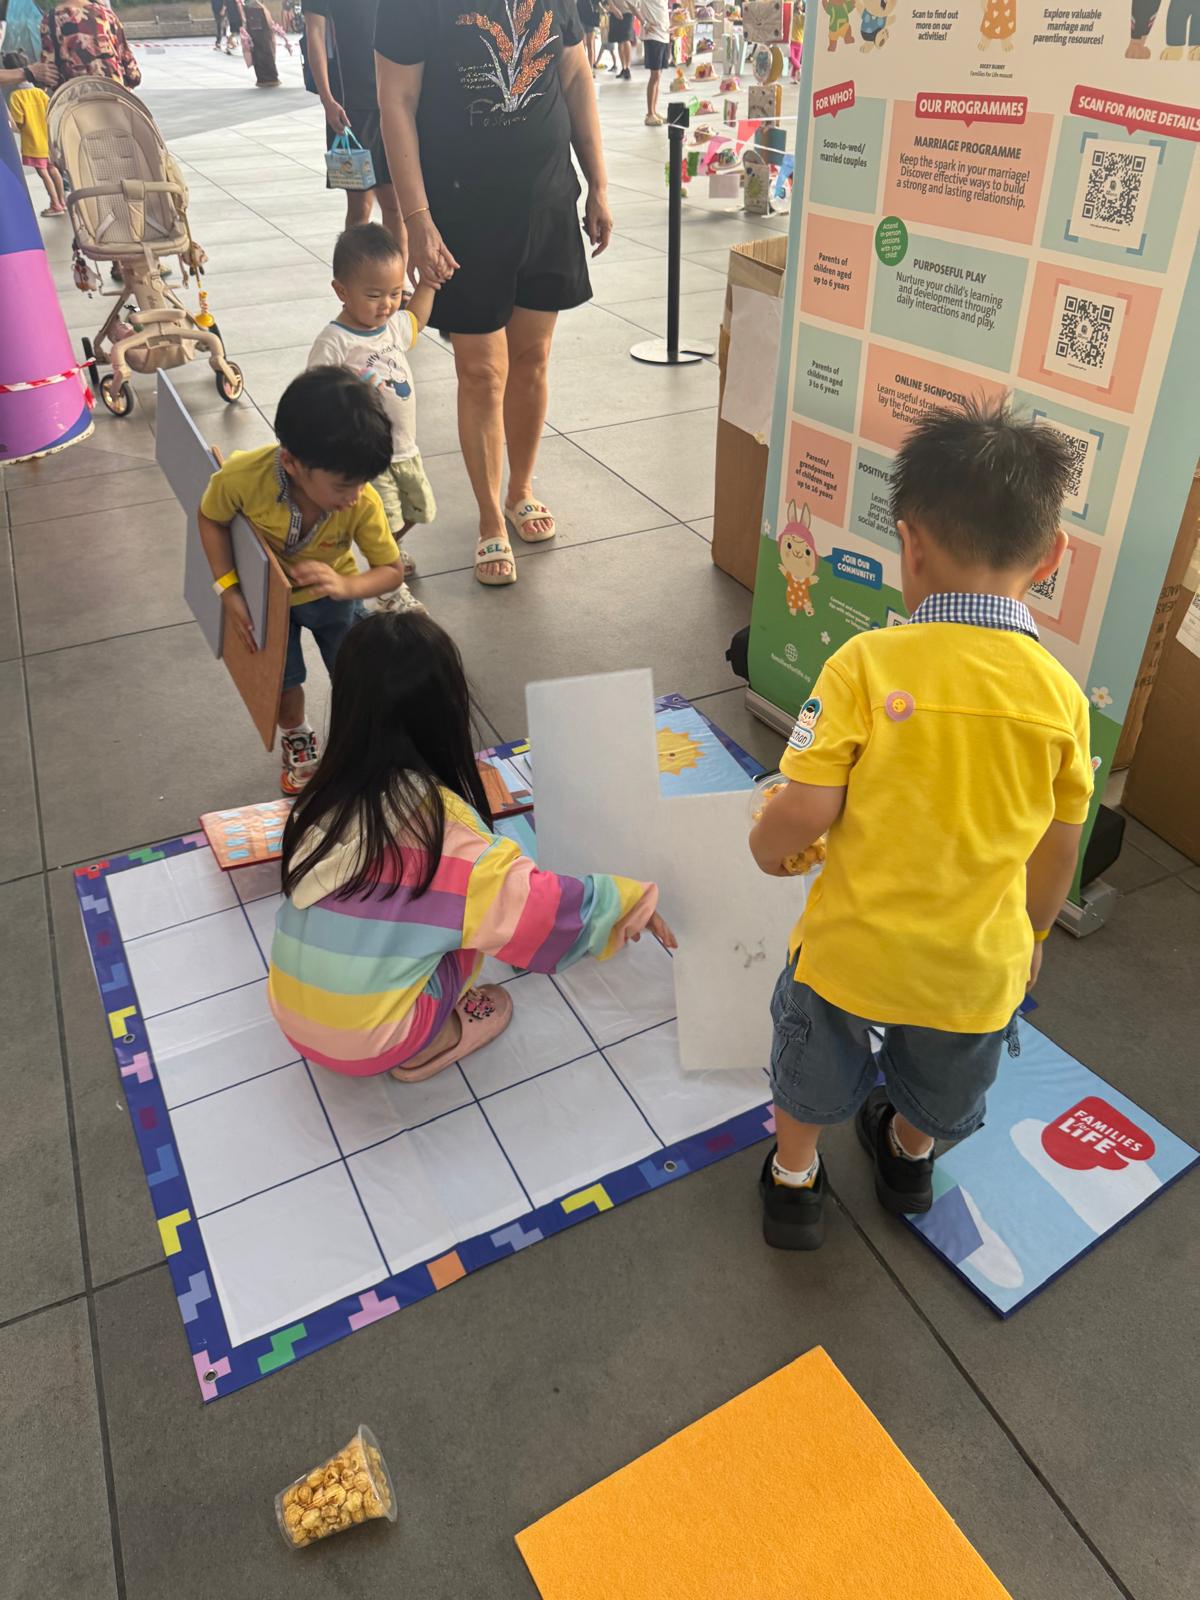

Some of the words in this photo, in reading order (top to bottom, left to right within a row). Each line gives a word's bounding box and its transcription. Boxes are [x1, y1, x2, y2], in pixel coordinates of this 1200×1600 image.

[912, 9, 926, 19] Scan
[927, 10, 933, 19] to
[934, 10, 947, 19] find
[947, 11, 958, 20] out
[1043, 8, 1070, 20] Explore
[1071, 9, 1102, 20] valuable
[915, 22, 931, 30] more
[932, 22, 940, 30] on
[941, 22, 952, 30] our
[1047, 21, 1078, 33] marriage
[1079, 22, 1094, 32] and
[918, 31, 947, 41] activities!
[1033, 33, 1067, 46] parenting
[1068, 34, 1104, 45] resources!
[815, 96, 829, 111] FOR
[829, 88, 854, 106] WHO?
[919, 98, 942, 113] OUR
[943, 99, 1025, 117] PROGRAMMES
[1078, 95, 1105, 113] SCAN
[1105, 100, 1125, 117] FOR
[1125, 105, 1158, 124] MORE
[1158, 111, 1200, 132] DETAILS
[823, 139, 866, 155] Soon-to-wed/
[914, 135, 959, 151] MARRIAGE
[960, 141, 1022, 160] PROGRAMME
[820, 152, 843, 164] married
[843, 156, 867, 168] couples
[899, 152, 919, 167] Keep
[919, 155, 933, 168] the
[934, 158, 956, 173] spark
[957, 162, 966, 173] in
[967, 165, 986, 176] your
[987, 167, 1030, 184] marriage!
[900, 165, 932, 181] Discover
[933, 170, 968, 186] effective
[969, 178, 990, 191] ways
[992, 180, 1002, 191] to
[1003, 180, 1025, 195] build
[896, 179, 901, 188] a
[903, 179, 927, 195] strong
[928, 183, 943, 194] and
[944, 185, 972, 202] lasting
[973, 188, 1026, 210] relationship.
[818, 252, 840, 265] Parents
[840, 258, 849, 266] of
[813, 263, 837, 277] children
[837, 269, 852, 280] aged
[913, 258, 964, 280] PURPOSEFUL
[965, 270, 987, 285] PLAY
[813, 276, 821, 286] up
[821, 277, 829, 286] to
[828, 279, 833, 287] 6
[833, 281, 850, 292] years
[896, 271, 925, 287] Nurture
[926, 280, 944, 291] your
[944, 283, 968, 298] child's
[969, 288, 1003, 310] learning
[898, 284, 913, 295] and
[913, 286, 963, 308] development
[964, 299, 997, 318] through
[896, 293, 915, 309] daily
[915, 297, 959, 319] interactions
[960, 311, 976, 324] and
[976, 315, 995, 331] play.
[811, 360, 832, 373] Parents
[833, 367, 840, 376] of
[806, 369, 829, 382] children
[829, 377, 844, 388] aged
[894, 374, 922, 391] ONLINE
[808, 379, 813, 387] 3
[813, 380, 820, 389] to
[819, 383, 824, 391] 6
[824, 385, 840, 397] years
[877, 383, 896, 397] Learn
[896, 391, 918, 405] useful
[878, 393, 888, 408] lay
[889, 399, 901, 410] the
[806, 451, 829, 468] Parents/
[800, 460, 834, 479] grandparents
[858, 462, 889, 482] POSITIVE
[801, 470, 822, 486] children
[823, 481, 837, 491] aged
[871, 492, 889, 506] Learn
[868, 511, 880, 522] and
[869, 503, 892, 517] promo
[858, 515, 876, 529] social
[876, 523, 888, 535] and
[1073, 1121, 1091, 1132] for
[1073, 1109, 1143, 1152] FAMILIES
